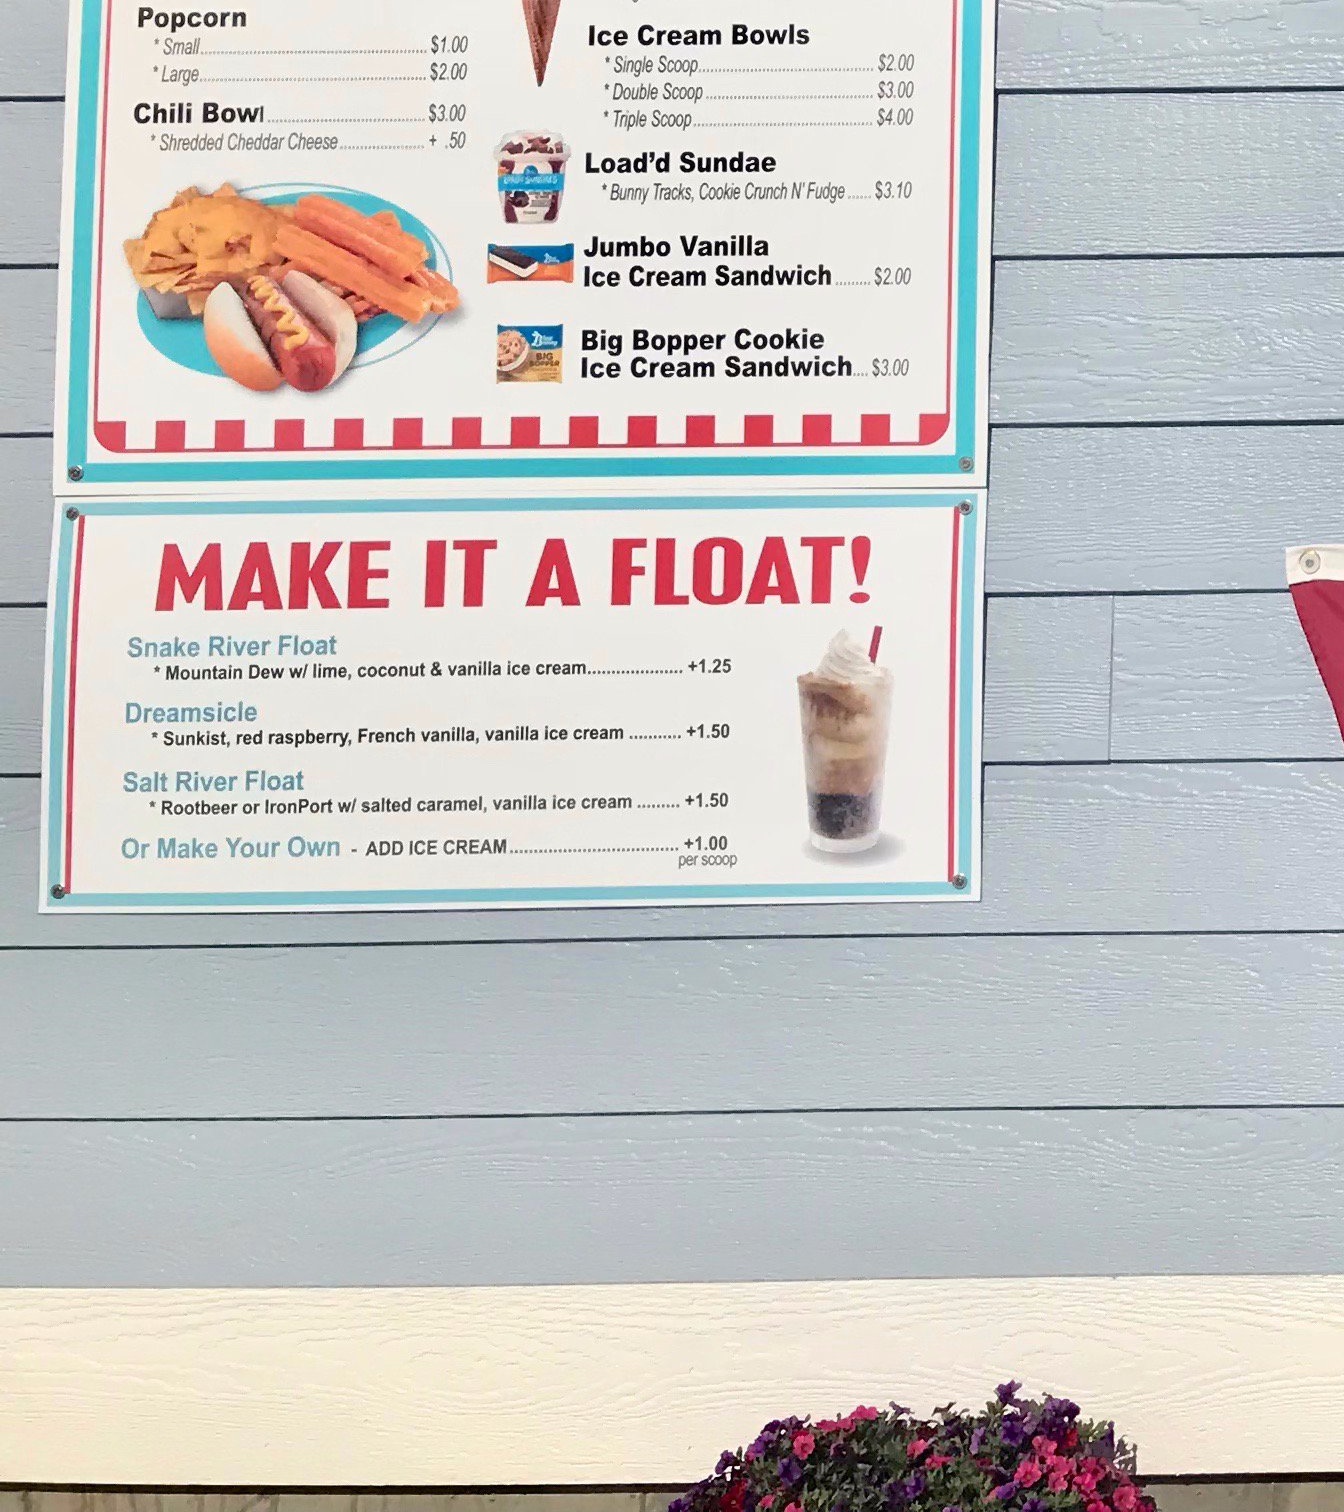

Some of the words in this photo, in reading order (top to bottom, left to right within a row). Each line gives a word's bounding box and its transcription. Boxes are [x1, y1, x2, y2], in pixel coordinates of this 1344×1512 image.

[138, 7, 246, 33] Popcorn
[614, 56, 653, 77] Single
[658, 55, 698, 76] Scoop
[680, 152, 776, 173] Sundae
[584, 236, 670, 257] Jumbo
[680, 235, 768, 256] Vanilla
[584, 266, 620, 287] Ice
[629, 266, 706, 287] Cream
[715, 264, 831, 286] Sandwich
[874, 267, 911, 287] $2.00
[582, 330, 622, 356] Big
[633, 330, 726, 355] Bopper
[735, 328, 824, 350] Cookie
[155, 541, 391, 611] MAKE
[424, 540, 497, 608] IT
[525, 538, 581, 606] A
[611, 536, 871, 606] FLOAT!
[127, 636, 200, 658] Snake
[209, 636, 271, 656] River
[278, 635, 337, 655] Float
[126, 701, 257, 723] Dreamsicle
[164, 731, 230, 747] Sunkist,
[236, 730, 263, 745] red
[121, 838, 150, 859] Or
[158, 838, 218, 858] Make
[226, 837, 280, 858] Your
[288, 836, 340, 857] Own
